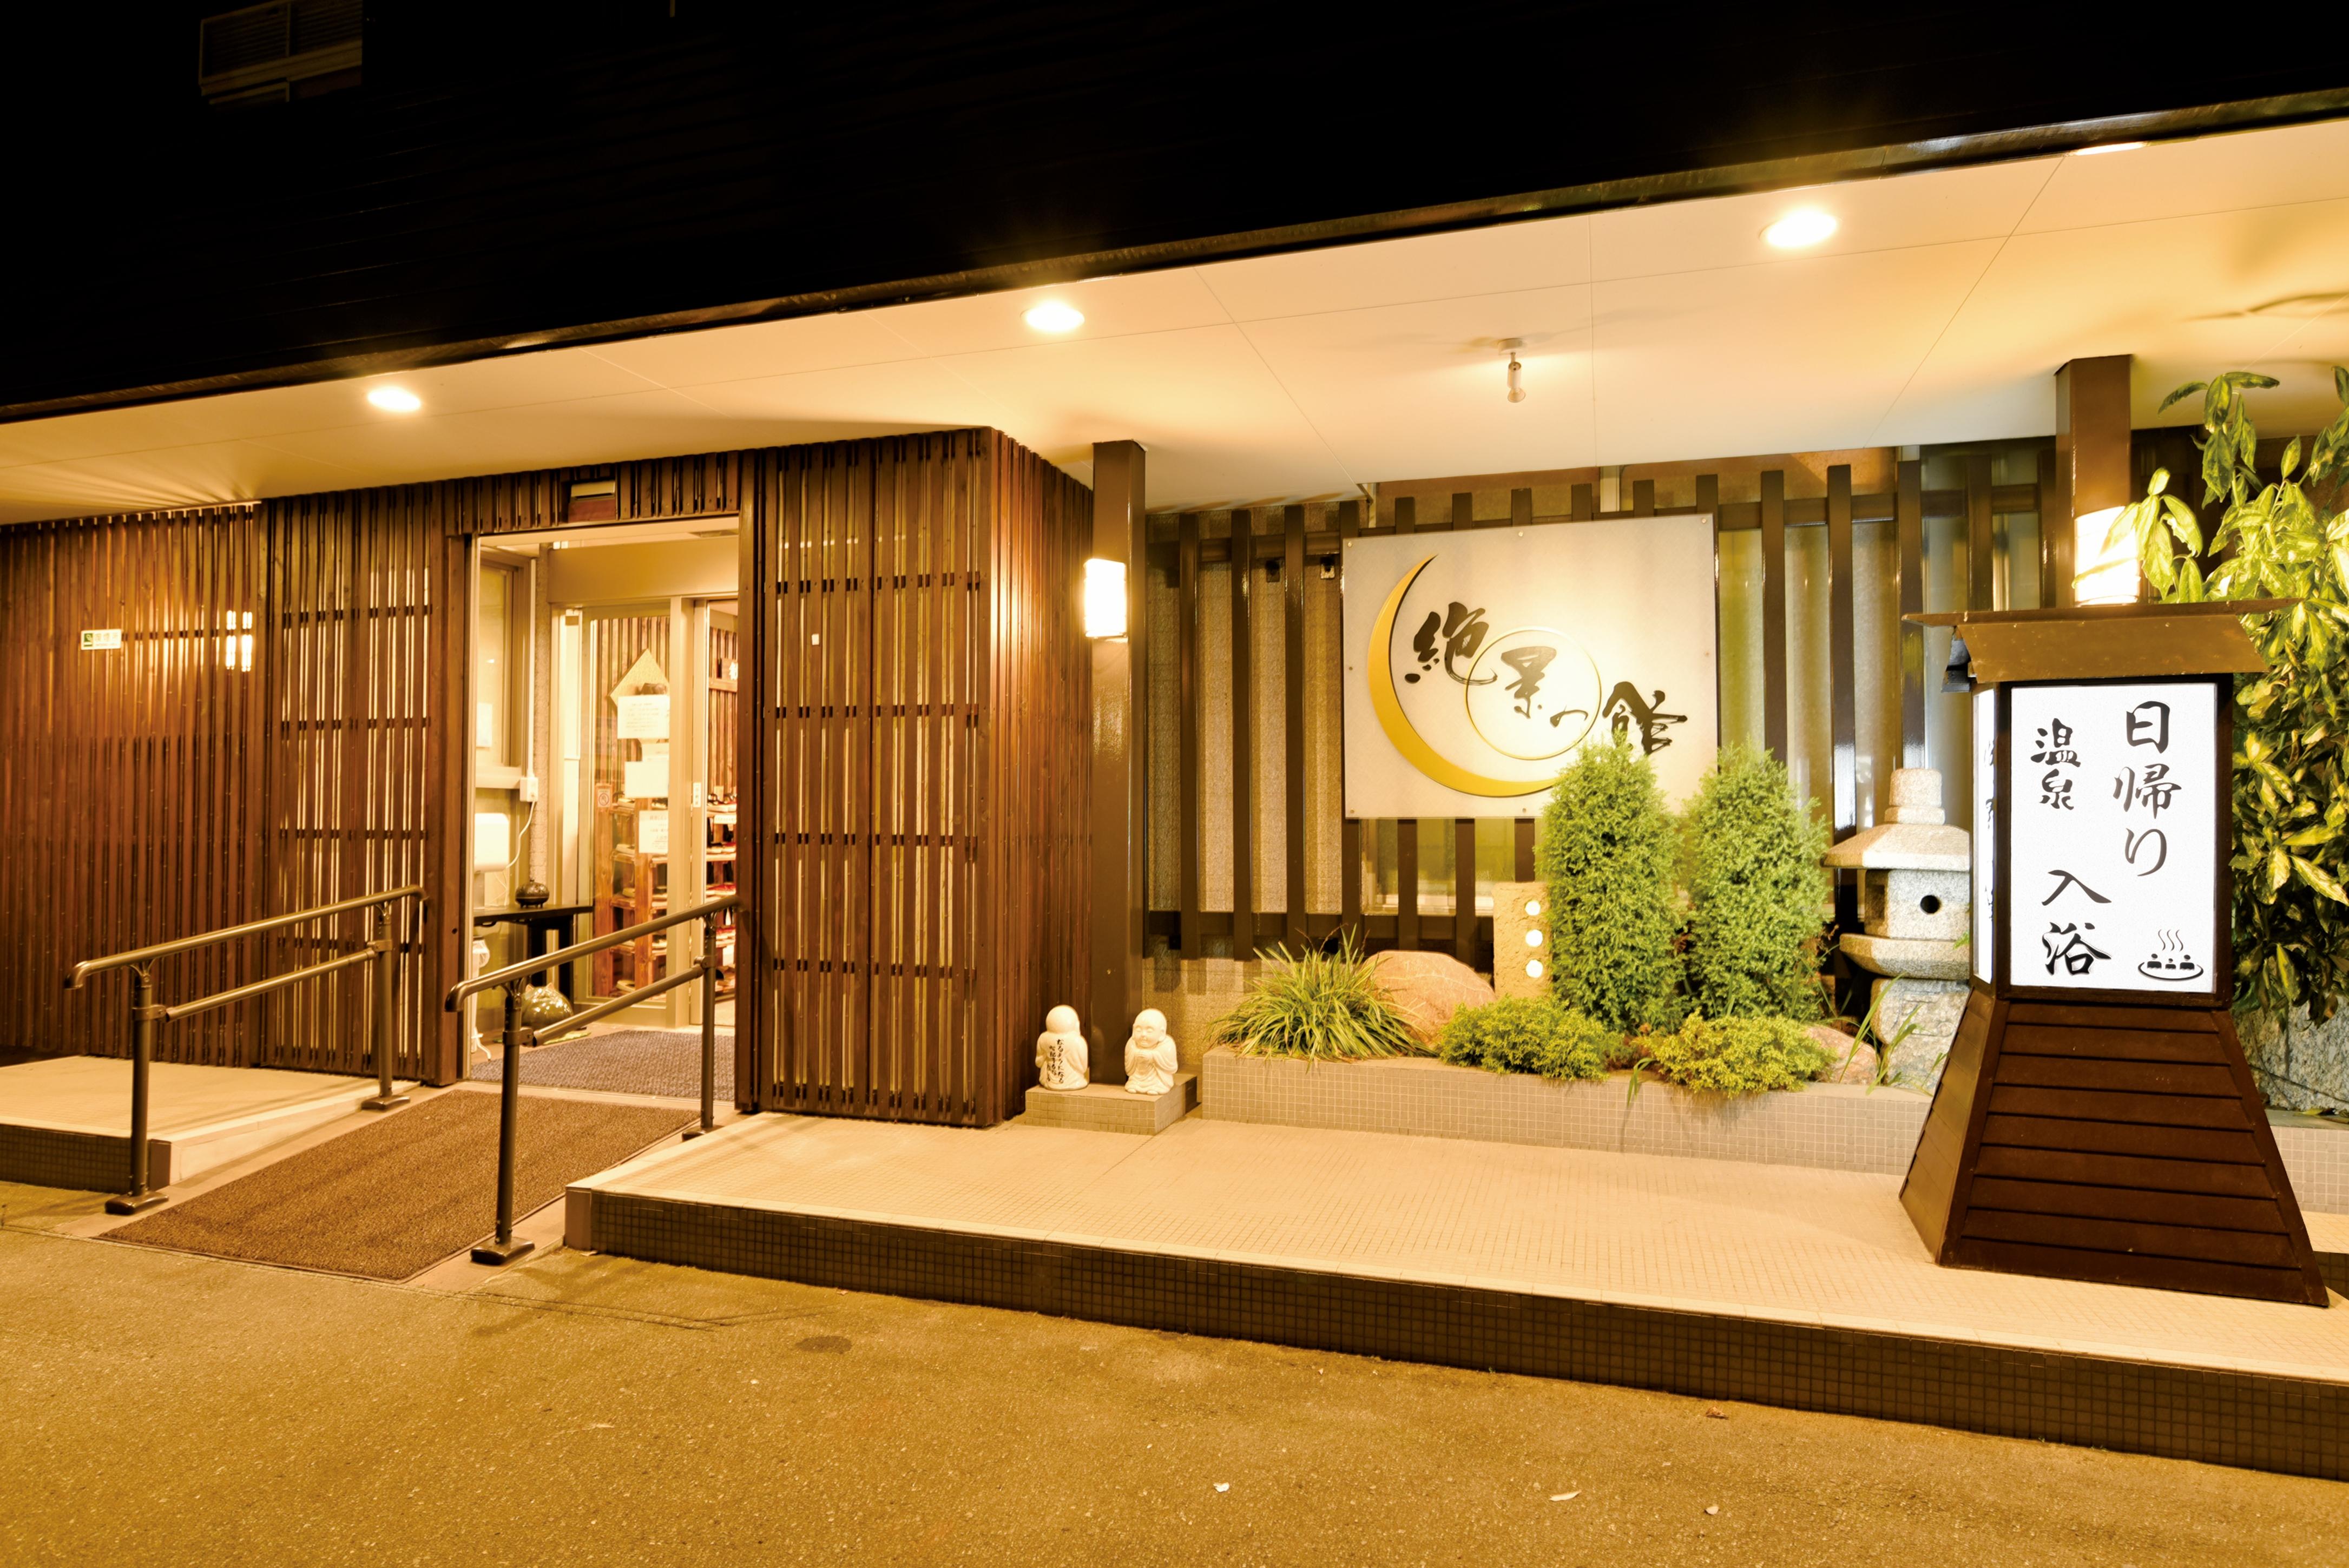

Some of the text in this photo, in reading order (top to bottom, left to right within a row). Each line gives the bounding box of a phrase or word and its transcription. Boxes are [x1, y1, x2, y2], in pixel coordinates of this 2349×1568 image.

[2031, 718, 2111, 976] 温泉 入浴
[2113, 701, 2182, 877] 日帰り
